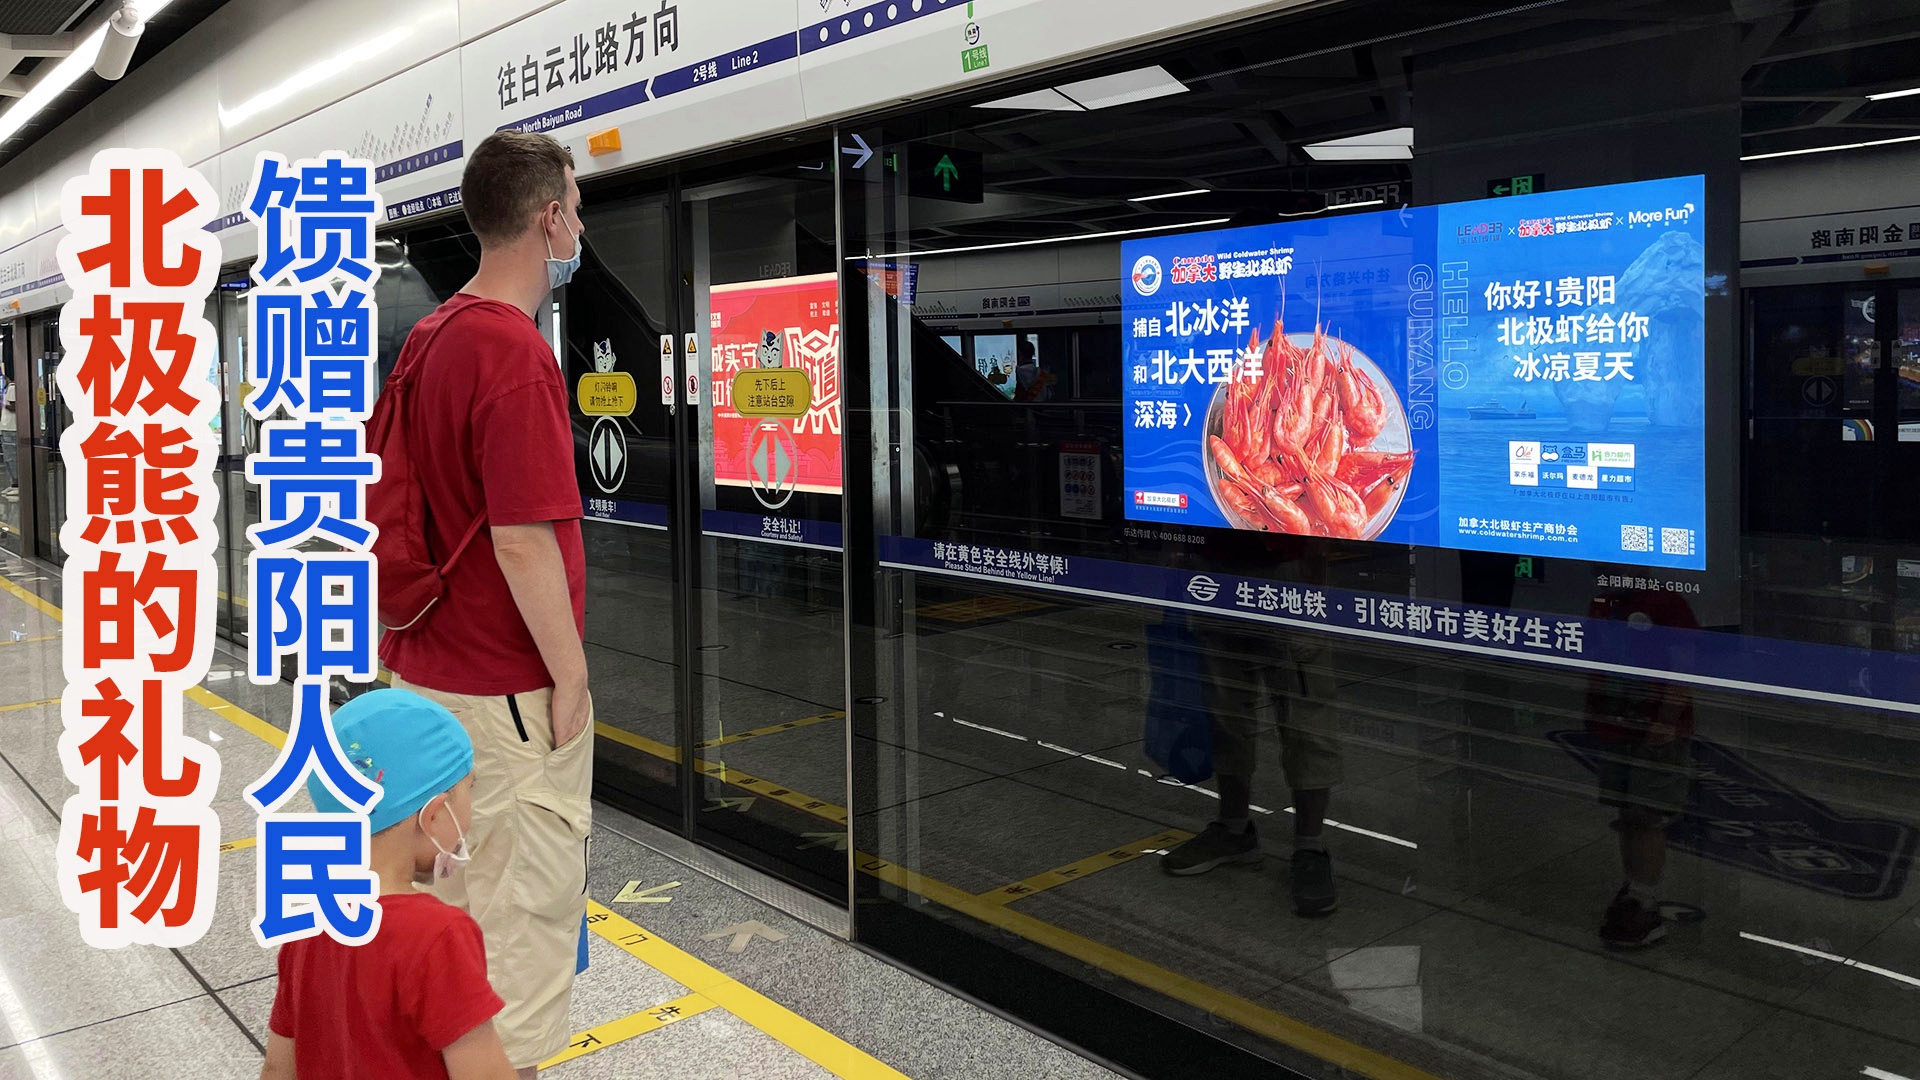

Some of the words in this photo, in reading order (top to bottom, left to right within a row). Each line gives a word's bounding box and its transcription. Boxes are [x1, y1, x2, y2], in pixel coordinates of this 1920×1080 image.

[497, 1, 679, 110] 往白云北路方向
[732, 56, 751, 70] Line
[753, 51, 758, 64] 2
[693, 61, 718, 82] 2号线
[523, 120, 541, 133] North
[542, 114, 564, 129] Baiyun
[565, 105, 582, 120] Road
[1628, 210, 1662, 225] More
[1665, 207, 1688, 221] Fun
[1173, 255, 1215, 265] Canada
[1217, 252, 1232, 260] Wild
[1233, 249, 1268, 259] Coldwater
[1269, 247, 1294, 257] Shrimp
[1484, 275, 1616, 312] 你好!贵阳
[1133, 317, 1161, 338] 捕自
[1165, 297, 1250, 337] 北冰洋
[1442, 261, 1468, 390] HELLO
[1497, 312, 1649, 346] 北极虾给你
[1408, 264, 1433, 430] GUIYANG
[1133, 365, 1147, 385] 和
[1151, 347, 1264, 385] 北大西洋
[1513, 352, 1635, 382] 冰凉夏天
[755, 378, 786, 391] 先下后上
[748, 395, 794, 408] 注意站台空隙
[1561, 446, 1585, 459] 盒马
[763, 516, 801, 534] 安全礼让!
[1458, 516, 1578, 536] 加拿大北极虾生产商协会
[1159, 532, 1172, 541] 400
[1173, 533, 1186, 542] 688
[1187, 535, 1205, 544] 8208
[1458, 528, 1578, 543] www.coldwatershrimp.com.cn
[933, 542, 1068, 576] 请在黄色安全线外等候!
[945, 561, 963, 571] Please
[965, 564, 981, 573] Stand
[983, 567, 1004, 576] Behind
[1006, 570, 1015, 578] the
[1016, 570, 1037, 581] Yellow
[1038, 574, 1055, 583] Line!
[1597, 574, 1700, 594] 金阳南路站-GB04
